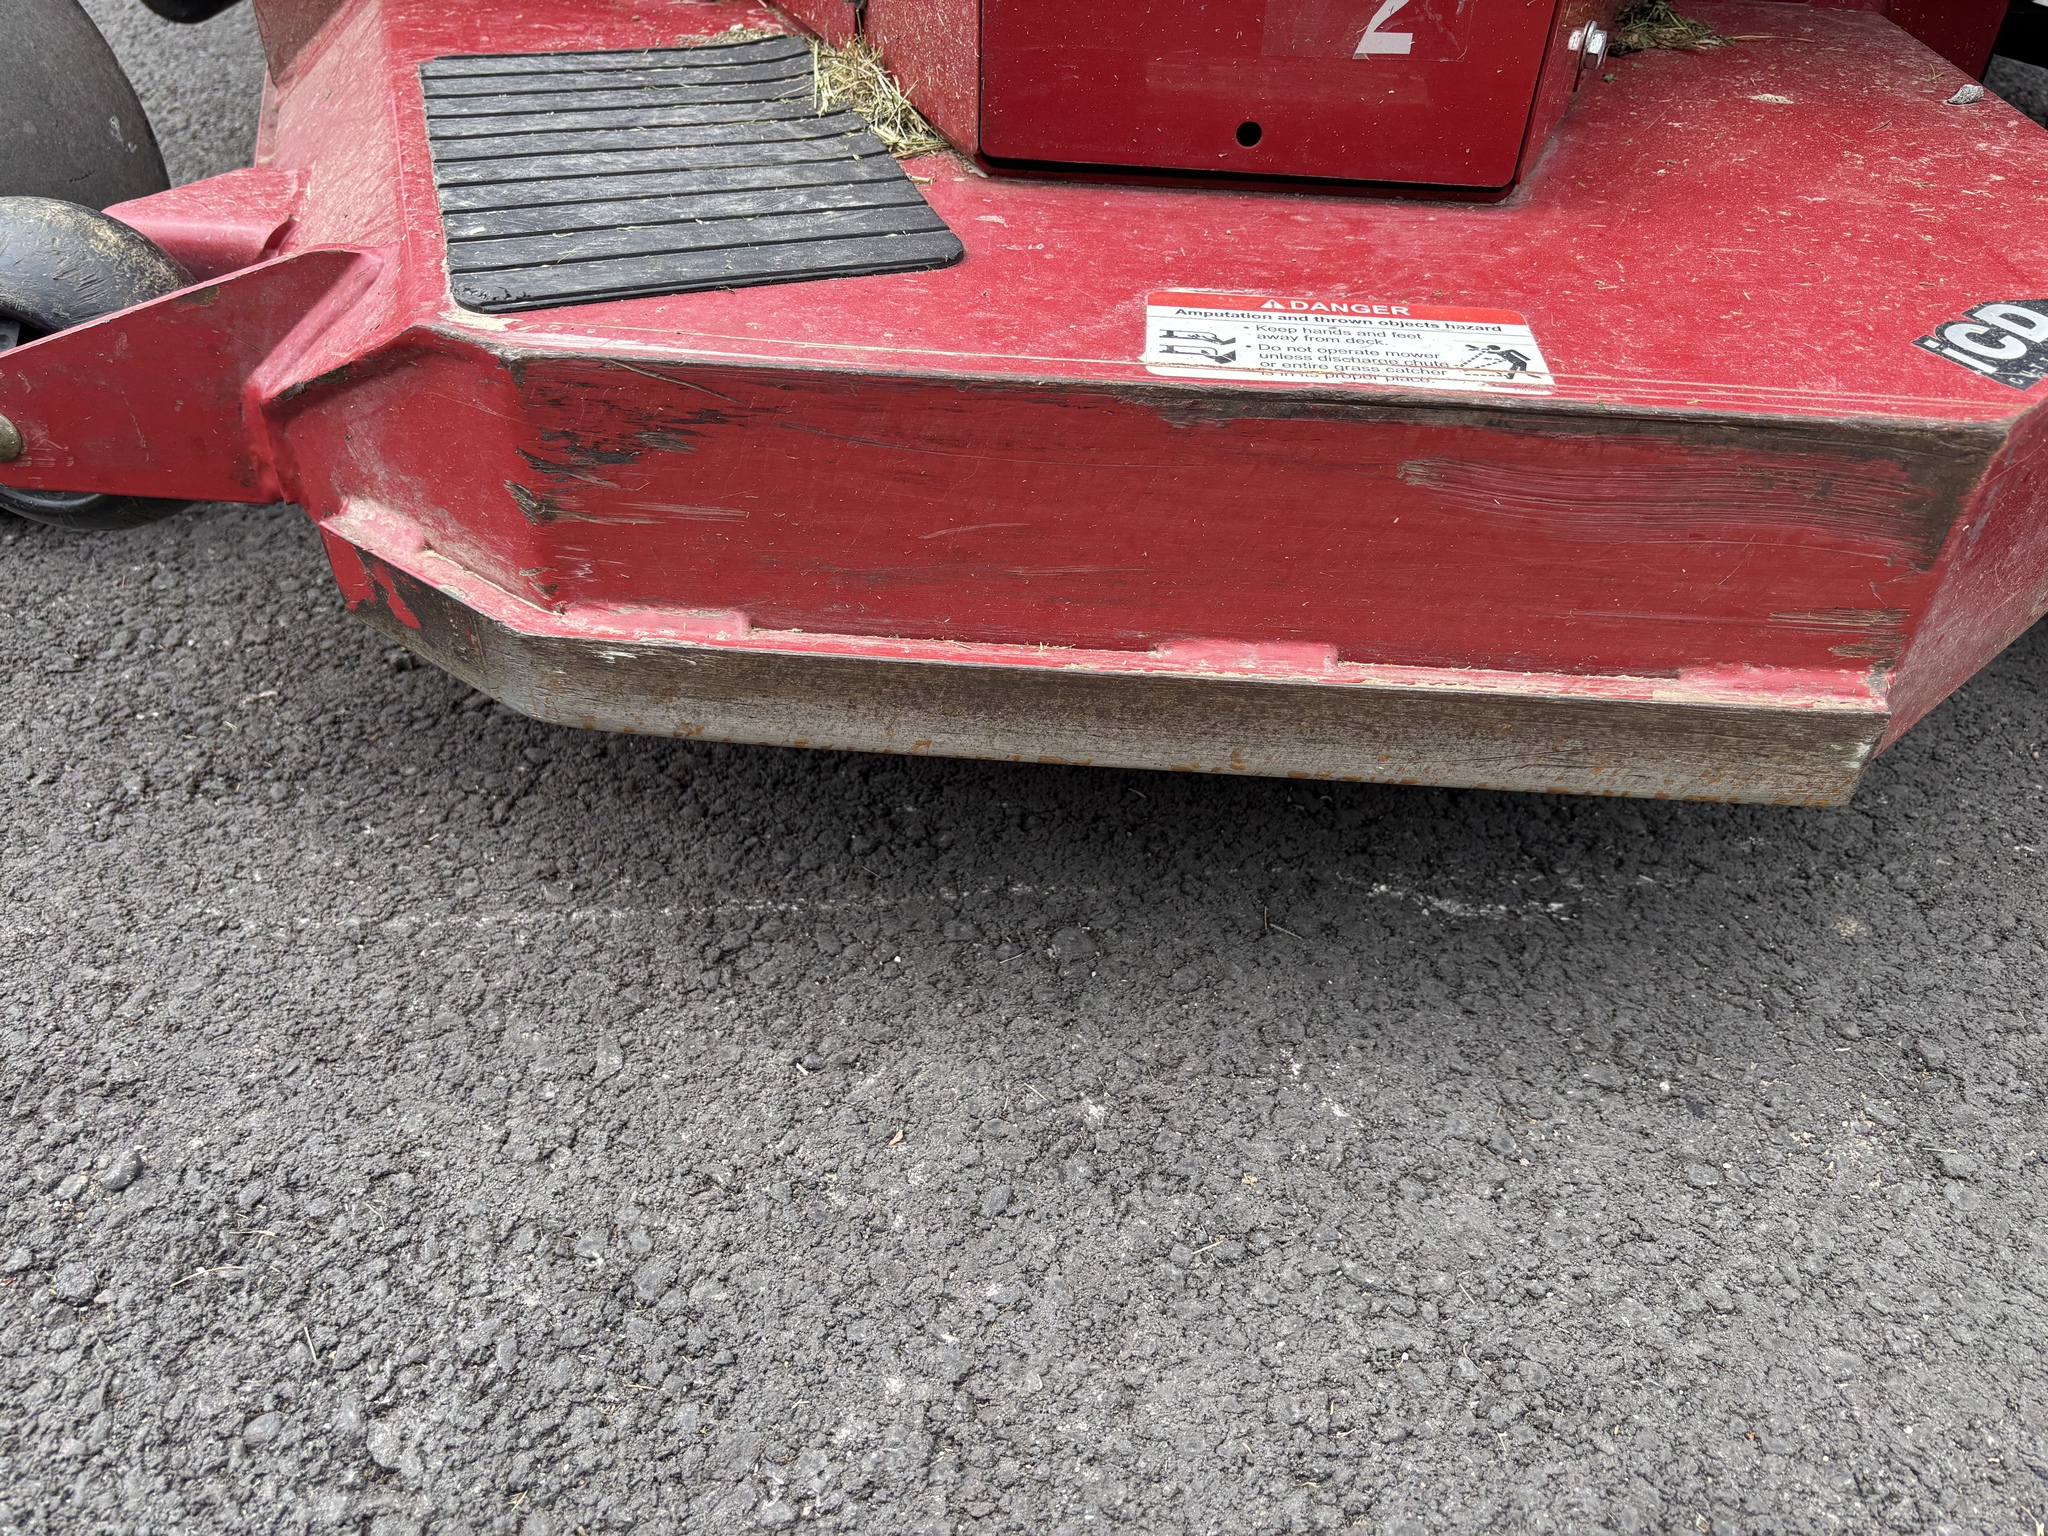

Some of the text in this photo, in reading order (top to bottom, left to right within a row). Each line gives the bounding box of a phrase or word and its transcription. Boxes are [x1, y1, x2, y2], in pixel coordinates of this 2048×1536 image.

[1290, 300, 1411, 316] DANGER
[1175, 309, 1272, 320] Amputation
[1313, 315, 1373, 325] thrown
[1378, 320, 1440, 328] objects
[1445, 322, 1502, 332] hazard
[1256, 324, 1423, 340] Keep hands and feet
[1256, 333, 1389, 346] away from deck.
[1258, 343, 1441, 360] Do not operate mower
[1259, 352, 1449, 368] unless discharge chute
[1280, 362, 1329, 370] entire
[1334, 364, 1380, 372] grass
[1385, 366, 1448, 376] catcher
[1324, 372, 1378, 380] proper
